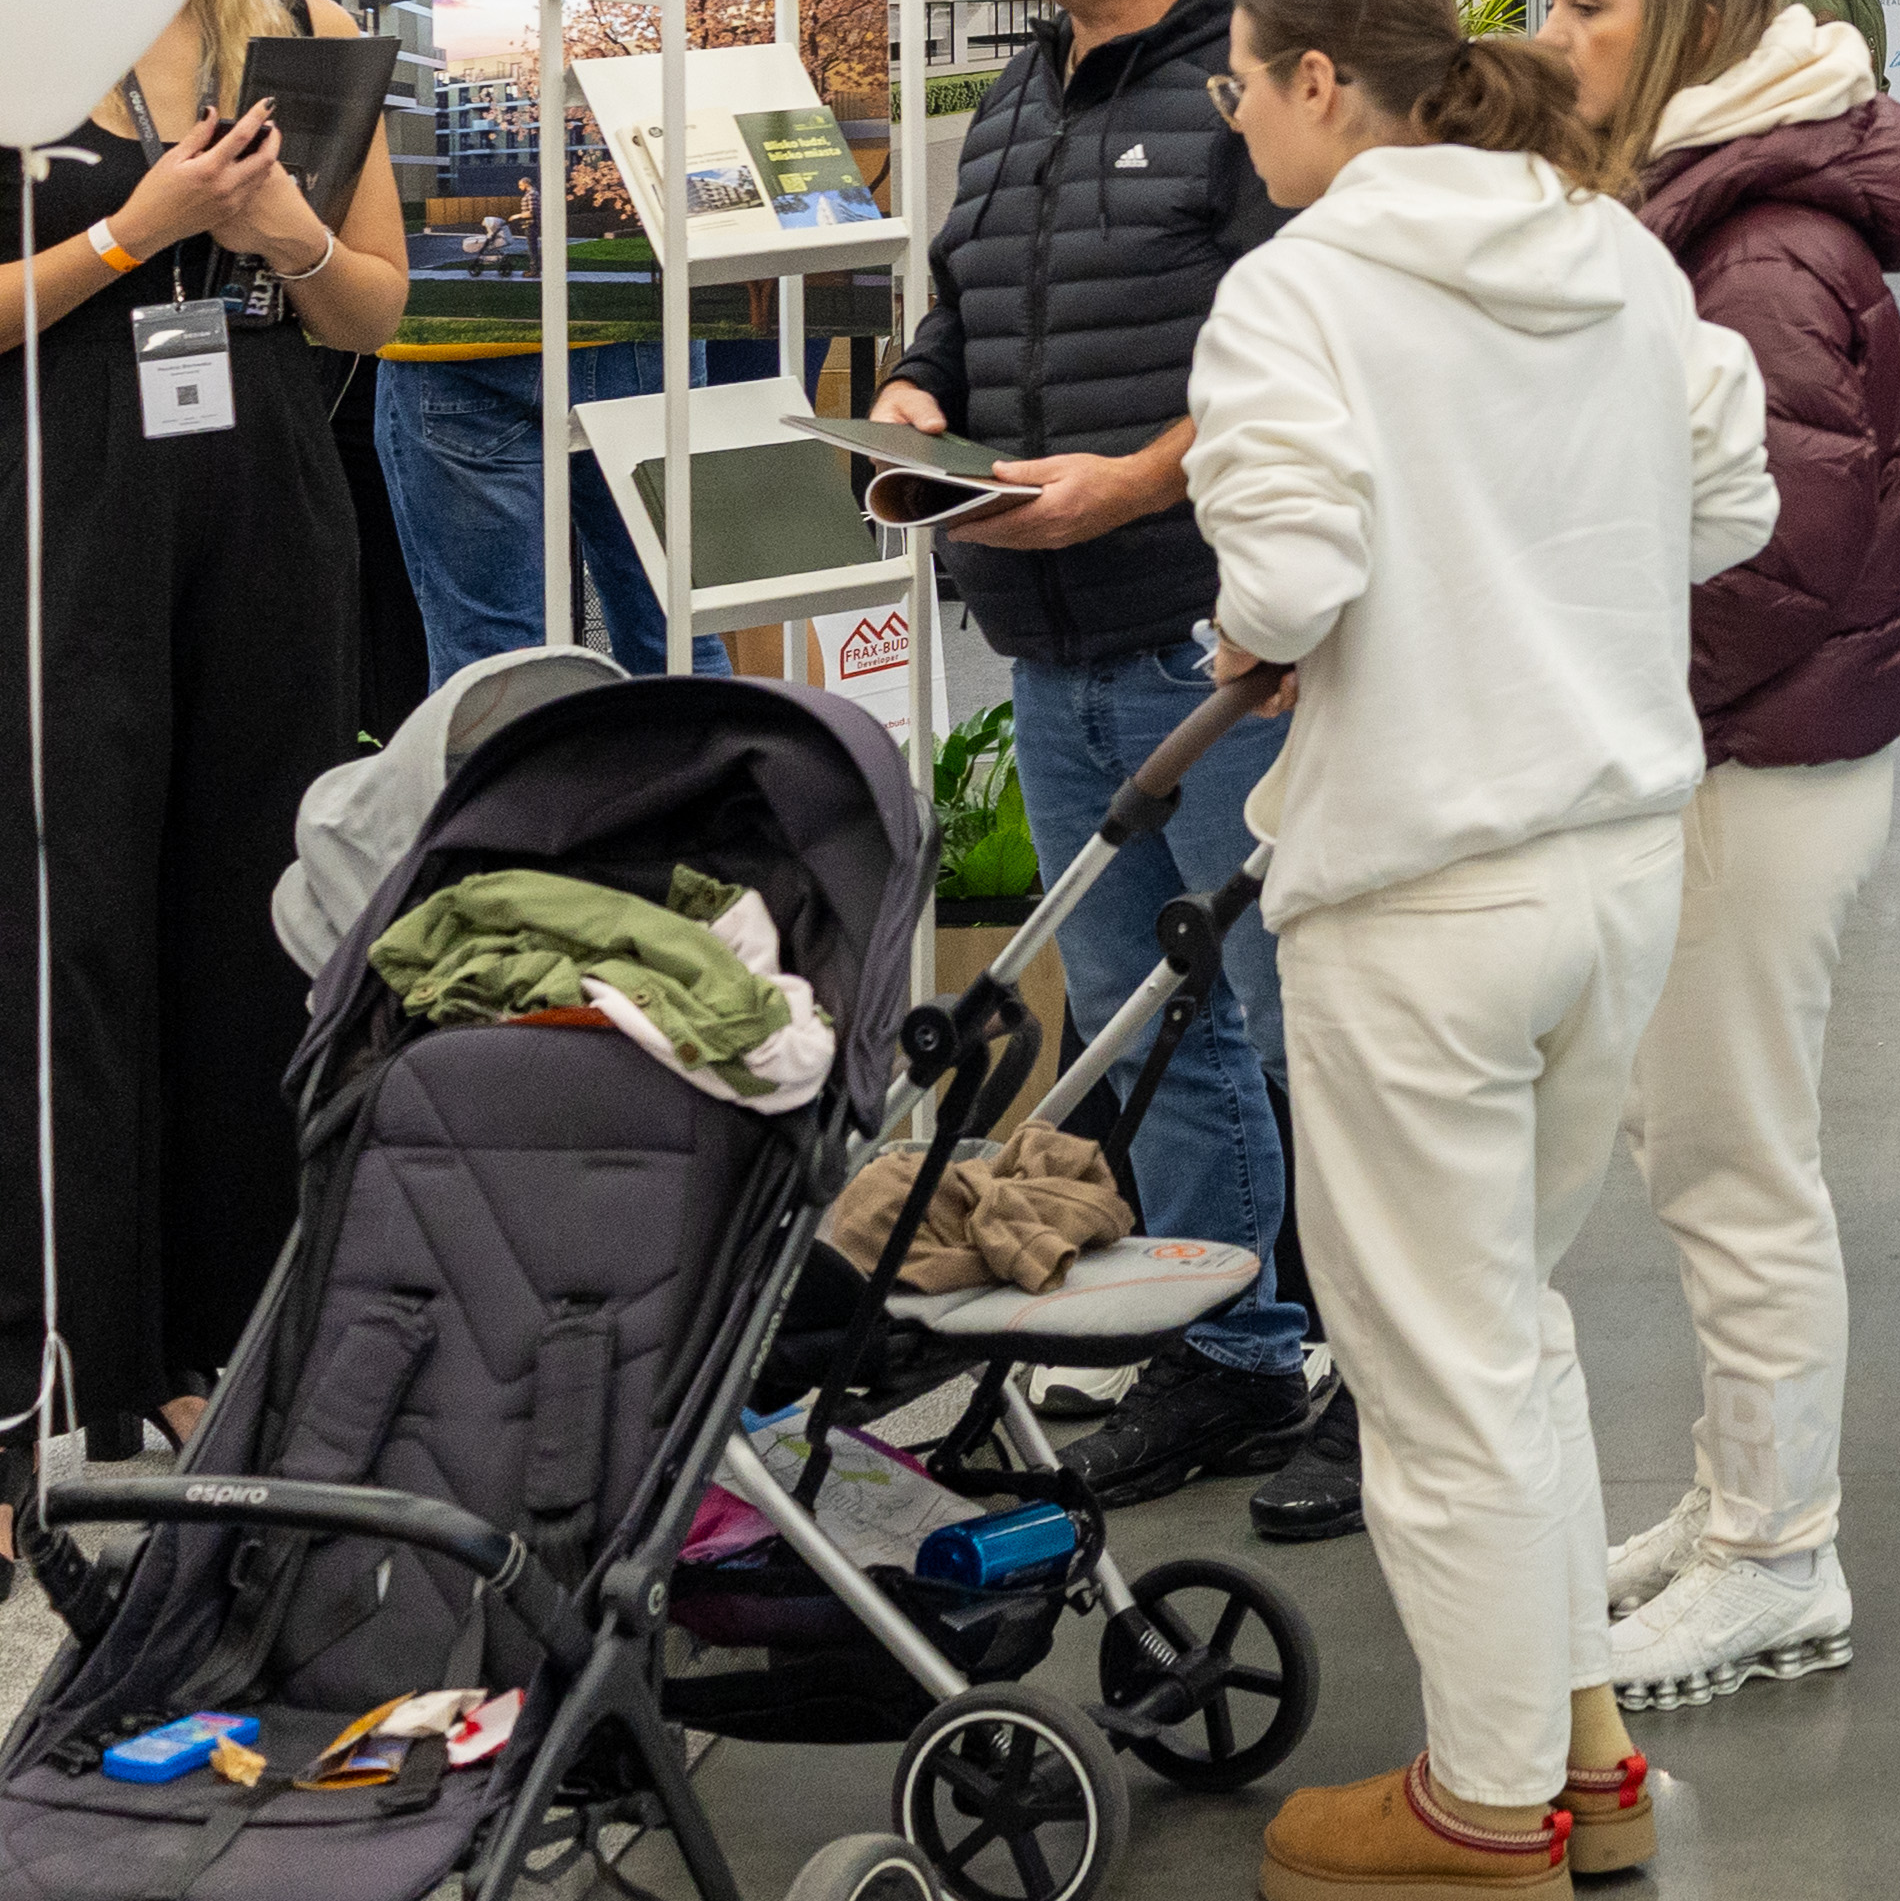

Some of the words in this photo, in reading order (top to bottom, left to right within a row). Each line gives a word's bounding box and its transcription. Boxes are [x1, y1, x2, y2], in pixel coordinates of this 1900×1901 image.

[845, 637, 909, 663] FRAX-BUD
[857, 653, 900, 670] Developer
[185, 1483, 270, 1507] espiro
